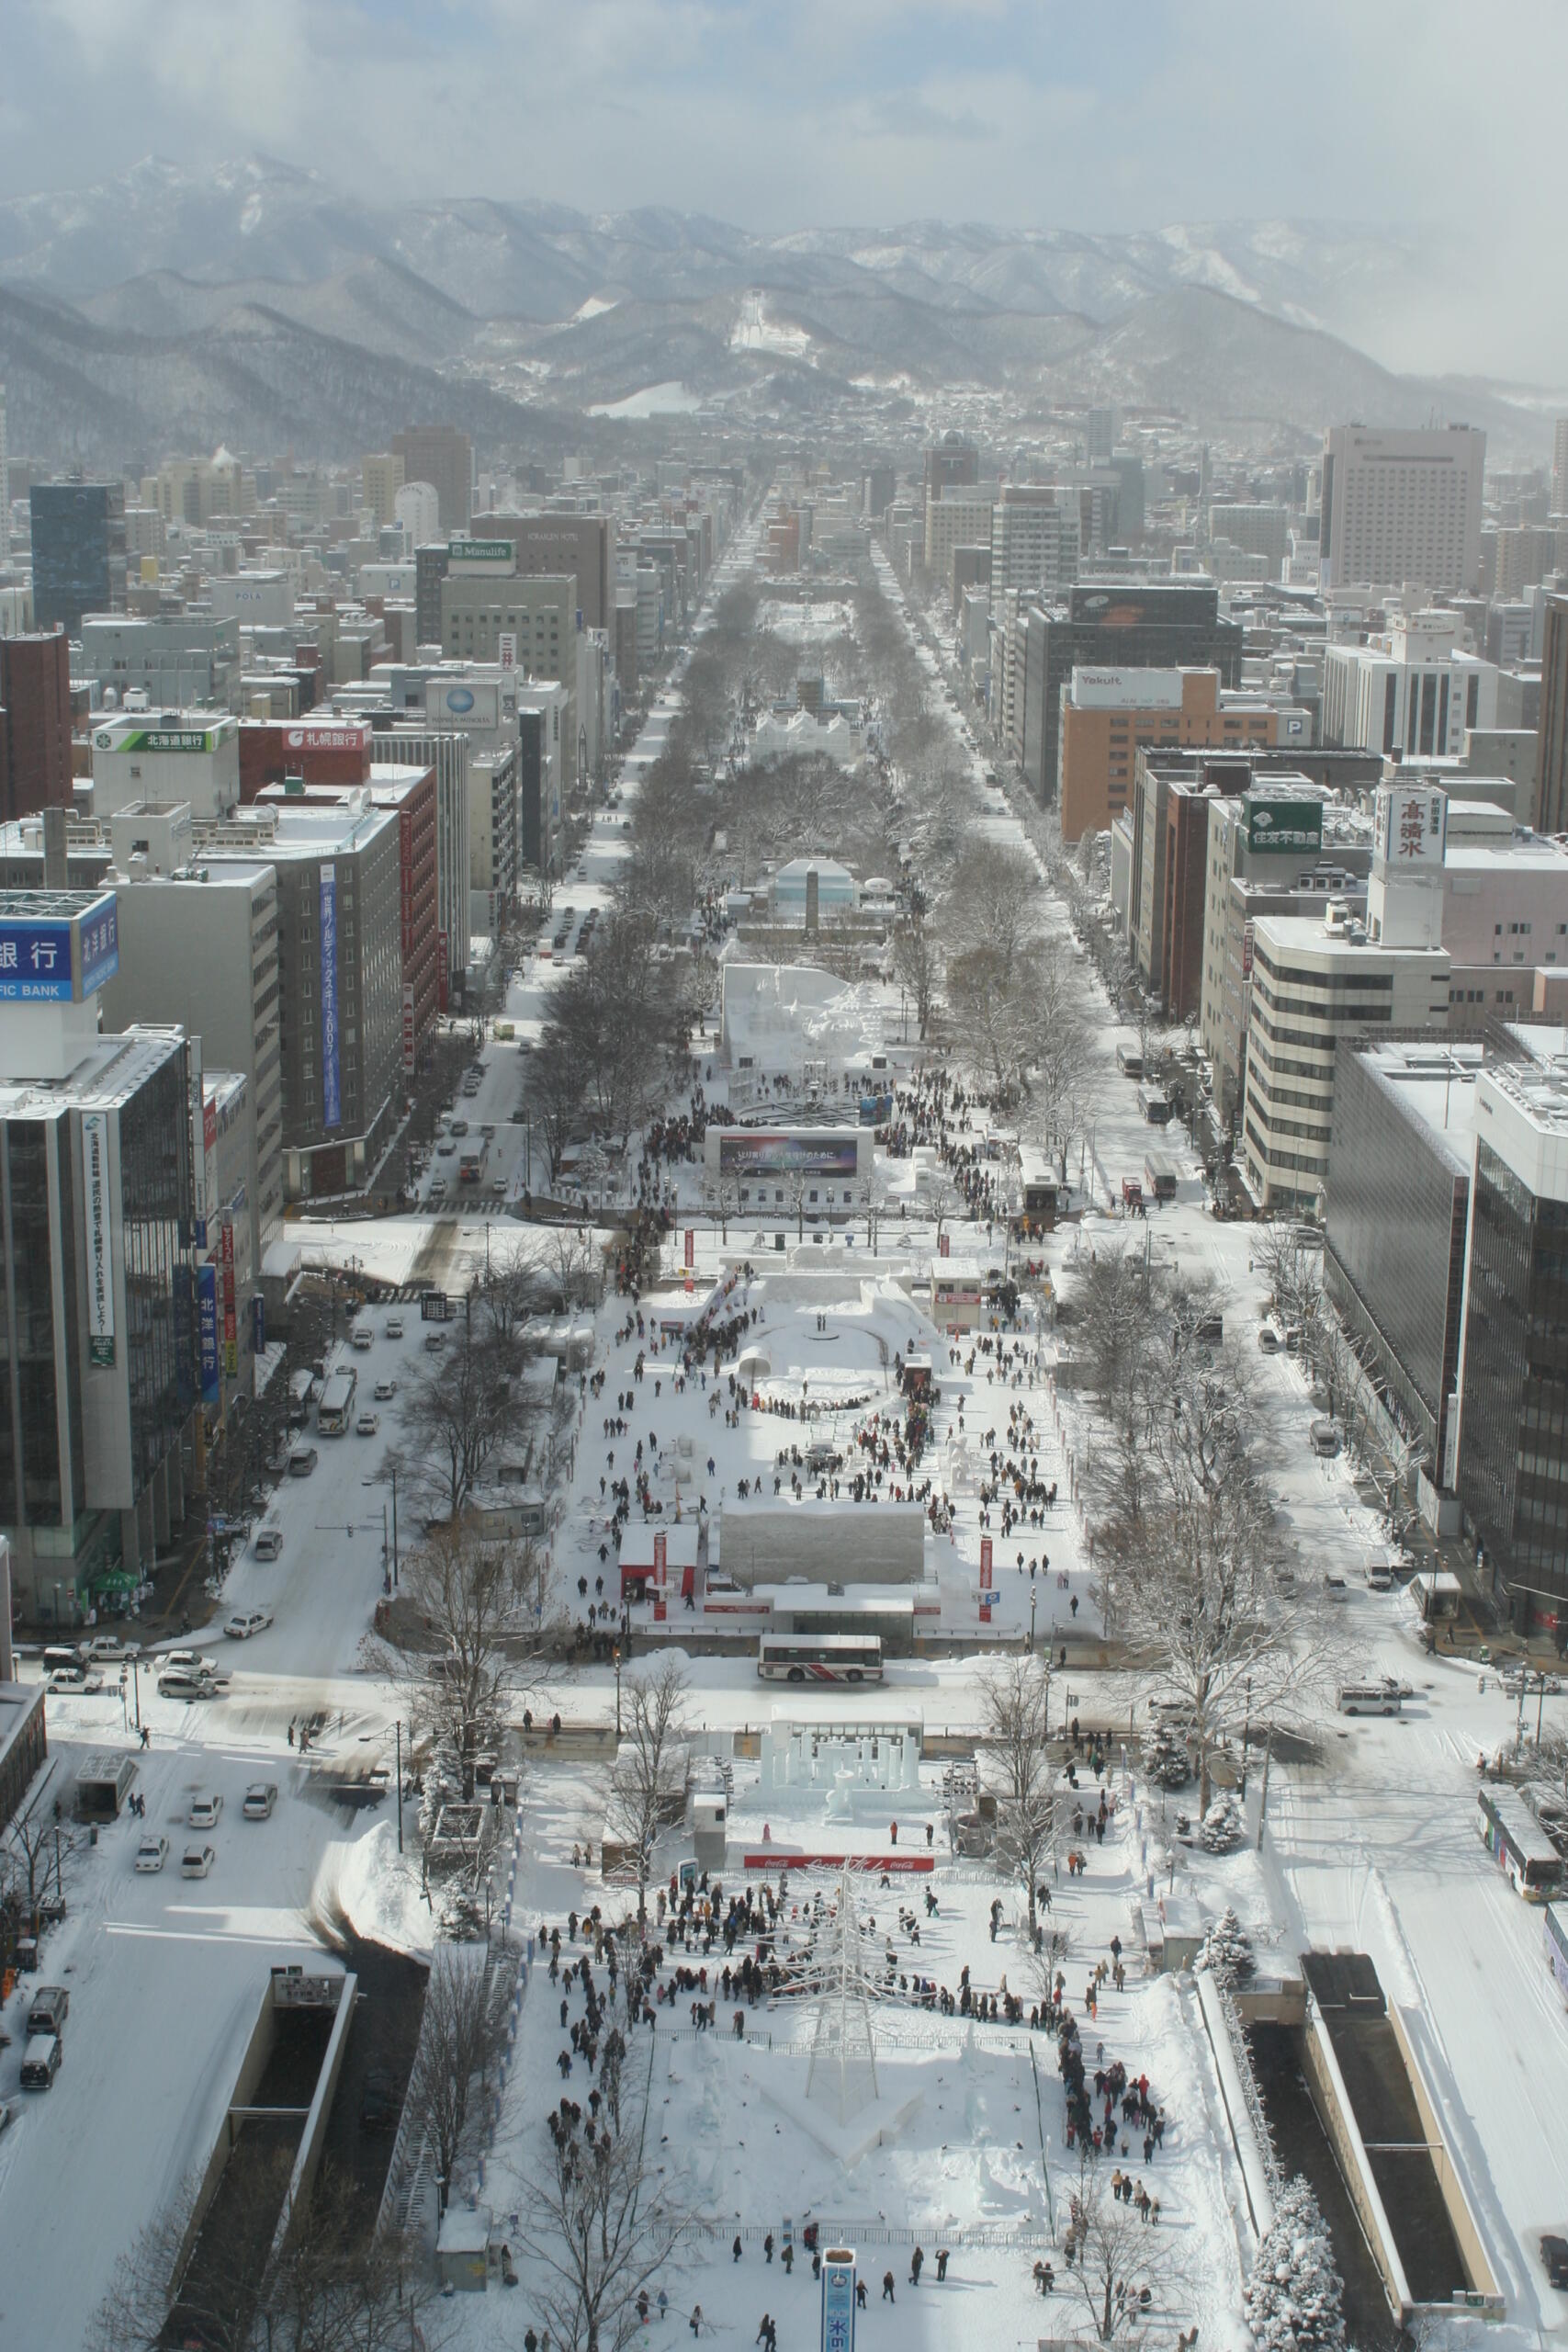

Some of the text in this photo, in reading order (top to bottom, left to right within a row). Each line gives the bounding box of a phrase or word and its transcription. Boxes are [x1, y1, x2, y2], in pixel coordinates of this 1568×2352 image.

[464, 546, 506, 557] Manulife
[502, 637, 513, 671] 三井
[1082, 675, 1122, 685] Yakult
[147, 734, 202, 746] 北海道銀行
[307, 731, 357, 746] 札幌銀行
[1253, 831, 1319, 844] 住友不動産
[22, 985, 60, 996] BANK
[200, 1297, 216, 1371] 北洋銀行
[829, 2319, 847, 2352] 氷の
